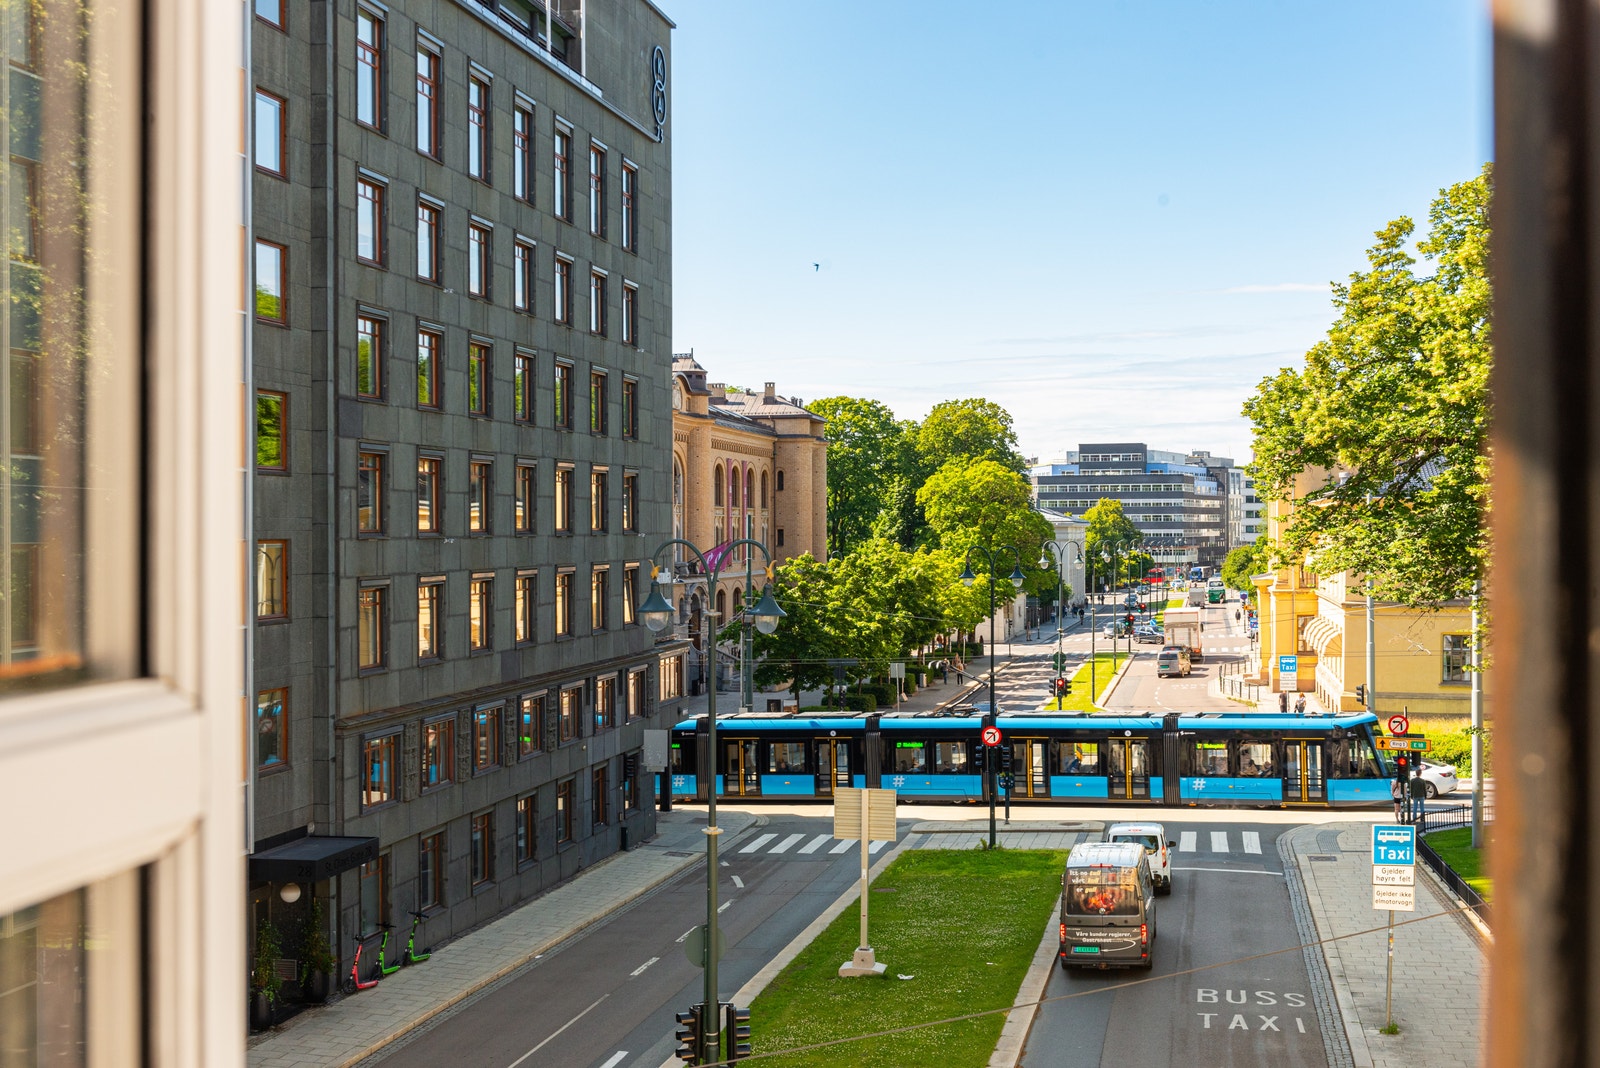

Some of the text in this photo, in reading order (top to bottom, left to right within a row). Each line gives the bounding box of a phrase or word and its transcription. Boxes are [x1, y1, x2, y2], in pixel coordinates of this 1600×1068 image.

[1378, 846, 1410, 860] Taxi
[298, 866, 313, 878] 28
[1376, 875, 1396, 883] høyre
[1197, 988, 1306, 1007] BUSS
[1196, 1012, 1306, 1034] TAXI
